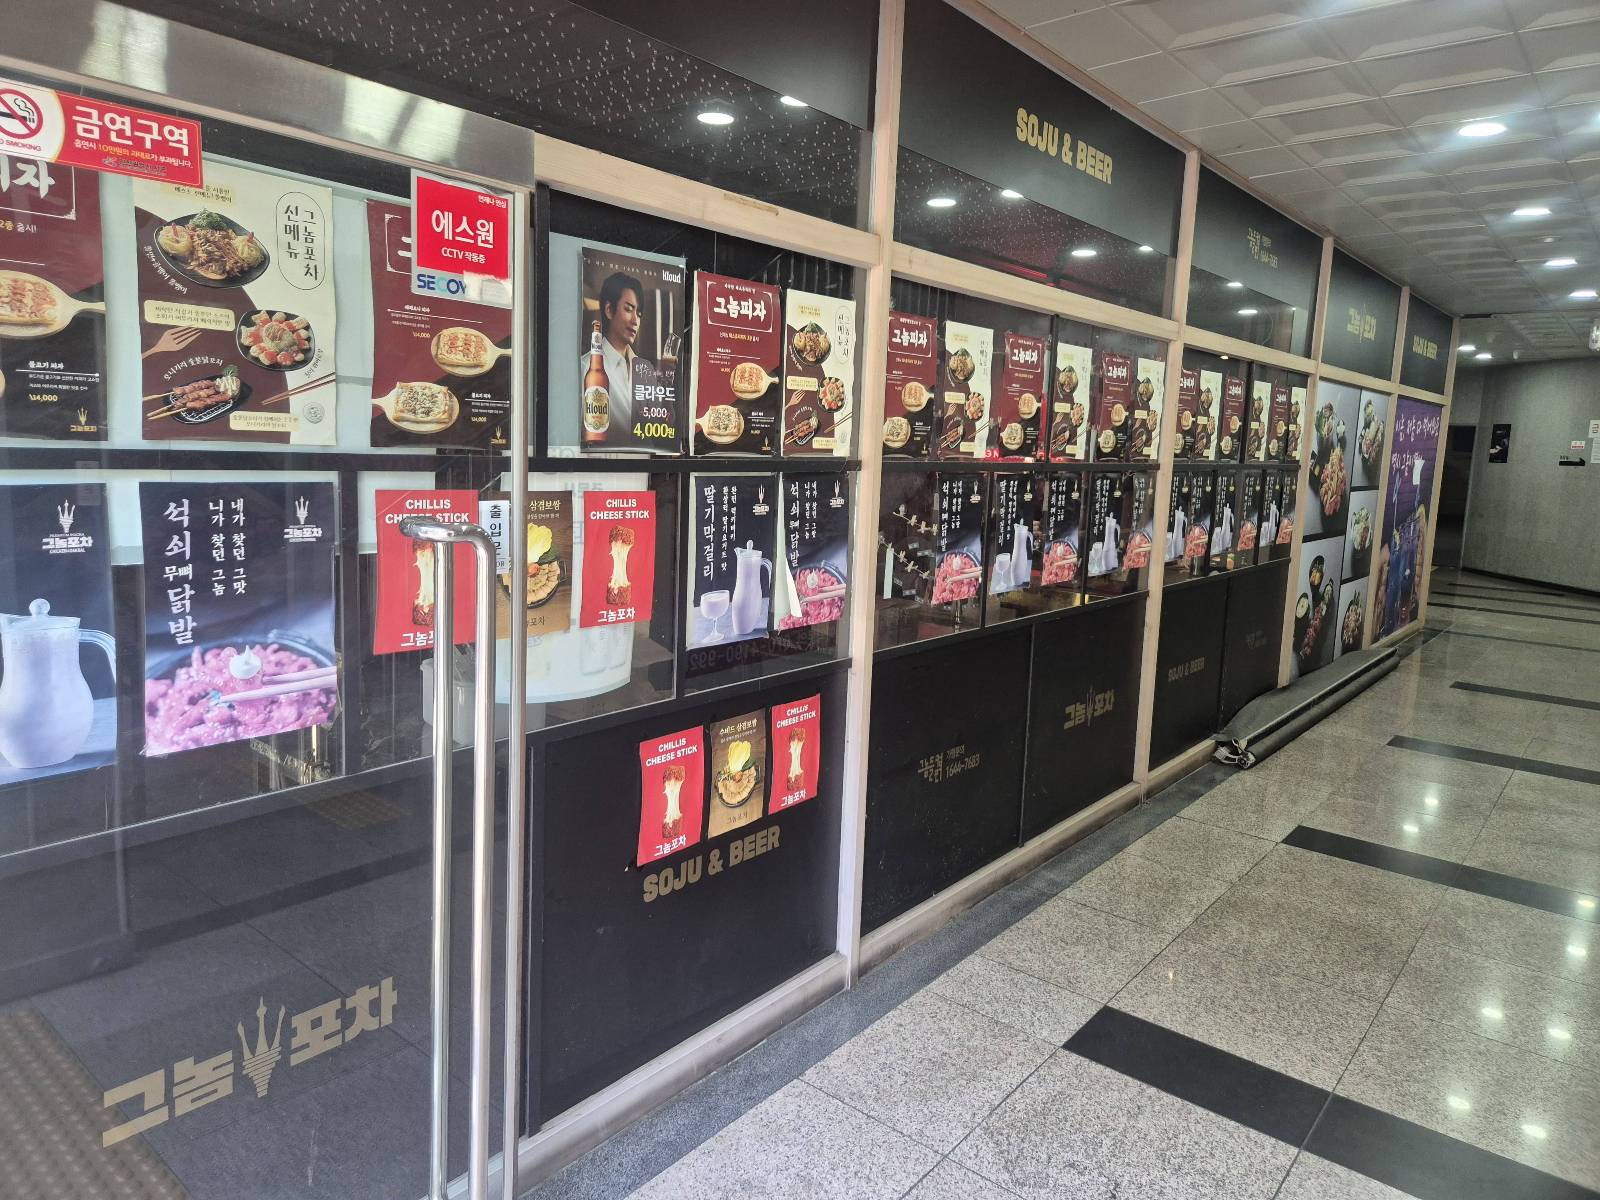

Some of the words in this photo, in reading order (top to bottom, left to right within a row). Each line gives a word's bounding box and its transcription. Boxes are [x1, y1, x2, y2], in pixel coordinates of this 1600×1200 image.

[72, 105, 189, 157] 금연구역
[5, 139, 42, 151] SMOKING
[73, 139, 97, 150] 흡연시
[1016, 107, 1059, 158] SOJU
[1061, 133, 1073, 166] &
[1077, 140, 1113, 184] BEER
[478, 195, 495, 206] 언제나
[495, 200, 507, 209] 안심
[284, 204, 300, 259] 신메뉴
[431, 209, 494, 249] 에스원
[302, 209, 319, 281] 그놈포차
[441, 247, 463, 260] CCTV
[464, 251, 486, 264] 작동중
[662, 269, 681, 283] Kloud
[713, 295, 767, 323] 그놈피자
[892, 328, 928, 349] 그놈피자
[28, 360, 49, 369] 불고기
[50, 362, 64, 370] 피자
[1011, 347, 1039, 365] 그놈피자
[634, 384, 676, 402] 클라우드
[643, 407, 668, 419] 5,000
[633, 422, 675, 439] 4,000원
[405, 499, 451, 510] CHILLIS
[530, 500, 561, 511] 삼겹보쌈
[606, 499, 637, 508] CHILLIS
[789, 481, 800, 519] 석쇠
[208, 499, 225, 527] 니가
[231, 498, 245, 527] 내가
[435, 512, 469, 523] STICK
[590, 510, 623, 520] CHEESE
[625, 510, 650, 519] STICK
[163, 499, 191, 561] 석쇠
[283, 528, 322, 538] 그놈포차
[703, 484, 717, 581] 딸기막걸리
[42, 536, 93, 549] 그놈포차
[212, 533, 226, 562] 찾던
[232, 533, 246, 561] 찾던
[790, 531, 800, 567] 닭발
[163, 563, 194, 582] 무뼈
[721, 562, 727, 571] 맛
[212, 568, 226, 597] 그놈
[233, 567, 247, 595] 그맛
[167, 584, 197, 645] 닭발
[597, 607, 636, 623] 그놈포차
[776, 714, 800, 728] CHEESE
[800, 710, 816, 723] STICK
[786, 704, 809, 717] CHILLIS
[658, 737, 686, 753] CHILLIS
[646, 751, 676, 767] CHEESE
[677, 744, 698, 758] STICK
[945, 754, 980, 779] 1644-7683
[780, 789, 807, 806] 그놈포차
[654, 833, 687, 857] 그놈포차
[642, 855, 703, 903] SOJU
[707, 848, 724, 876] &
[729, 825, 781, 868] BEER
[102, 976, 397, 1148] 그놈포차
